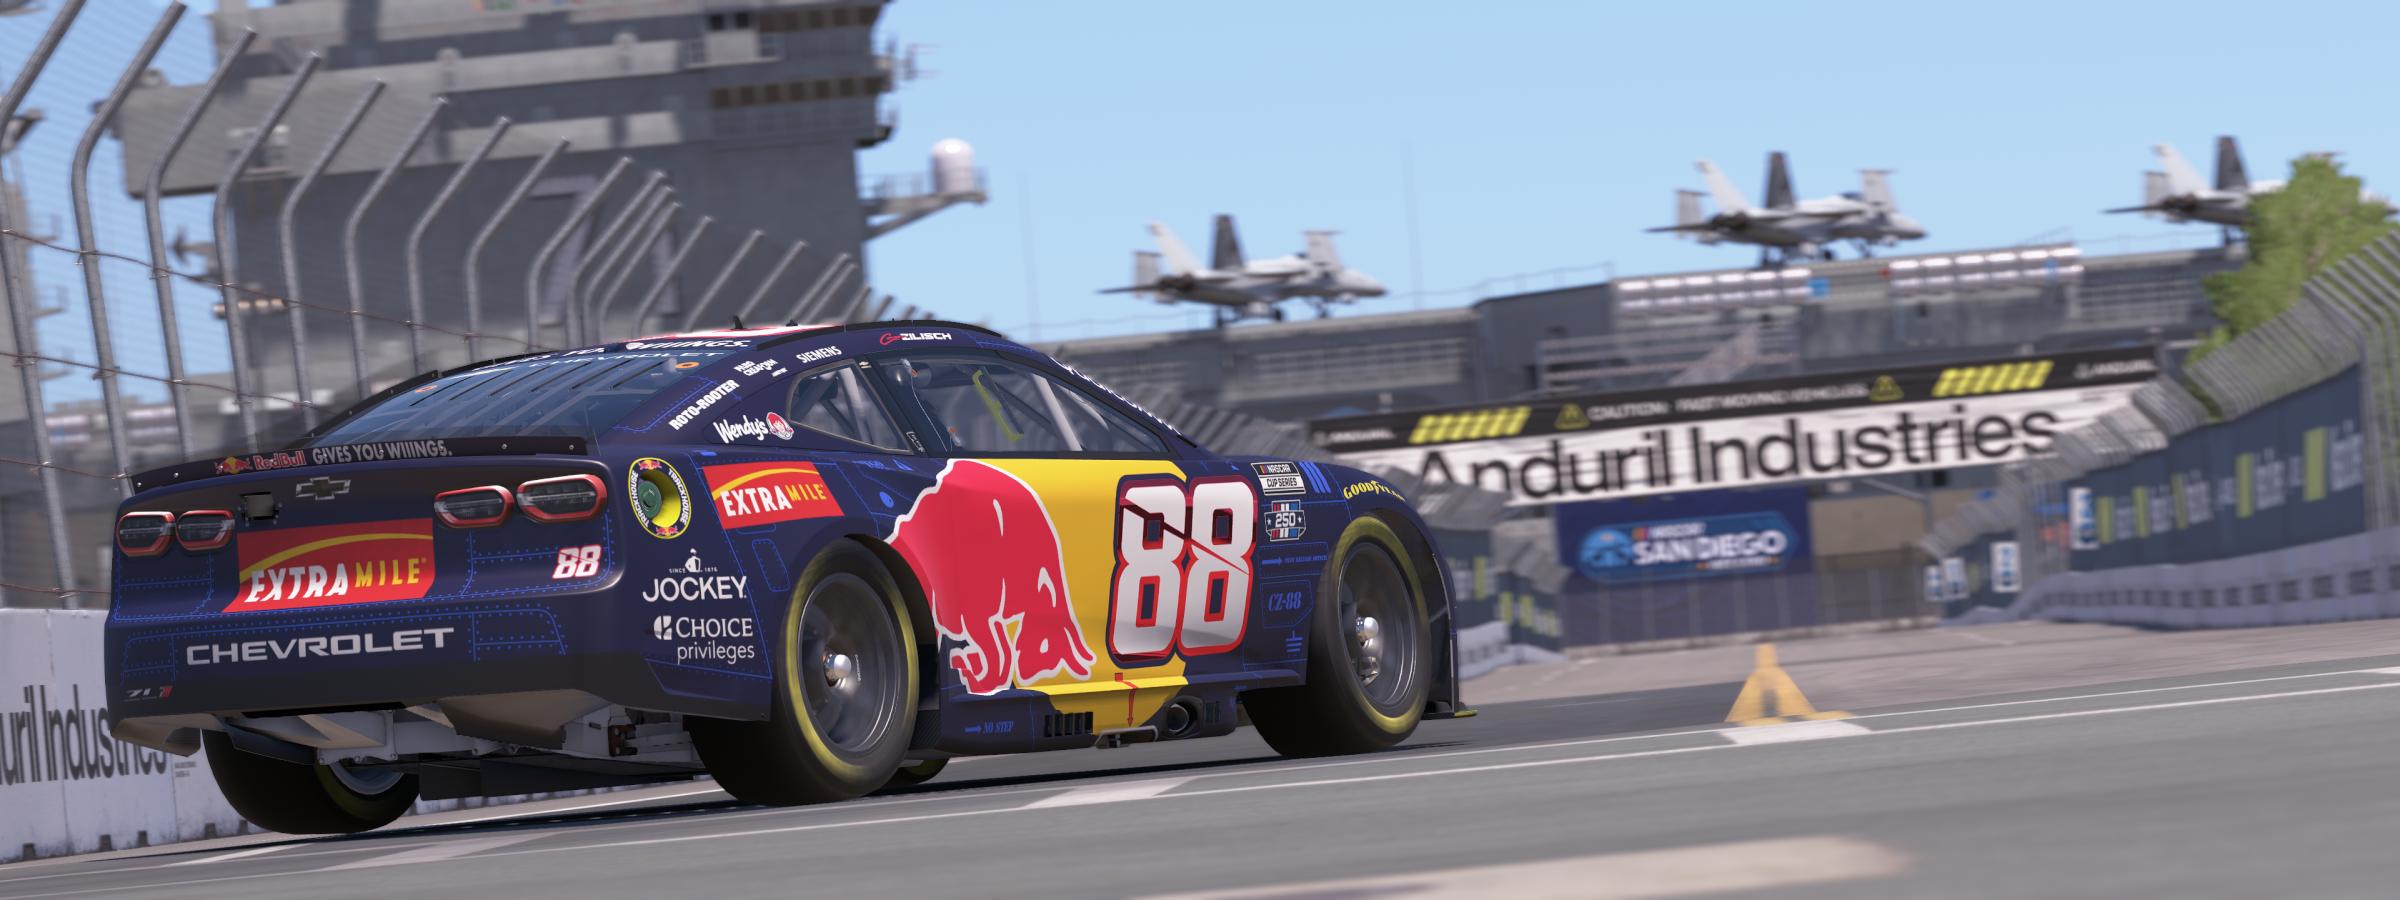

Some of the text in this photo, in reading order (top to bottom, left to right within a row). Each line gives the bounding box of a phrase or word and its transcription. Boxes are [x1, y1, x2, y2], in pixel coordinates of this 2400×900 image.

[796, 345, 842, 364] SIEMENS
[669, 379, 740, 430] ROTO-ROOTER
[713, 414, 769, 444] Wendy's
[313, 446, 352, 465] GIVES
[353, 443, 384, 461] YOU
[1420, 404, 2060, 499] Anduril Industries
[1266, 477, 1298, 488] CUP SERIES
[1267, 464, 1292, 473] NASCAR
[631, 469, 650, 528] TRACKHOUSE
[668, 468, 690, 525] TRACKHOUSE
[1275, 512, 1296, 528] 250
[552, 544, 602, 580] 88
[1632, 539, 1695, 566] SAN
[1696, 529, 1788, 560] DIEGO
[1109, 474, 1258, 664] 88
[675, 616, 754, 638] CHOICE
[186, 627, 454, 666] CHEVROLET
[676, 640, 756, 665] privileges
